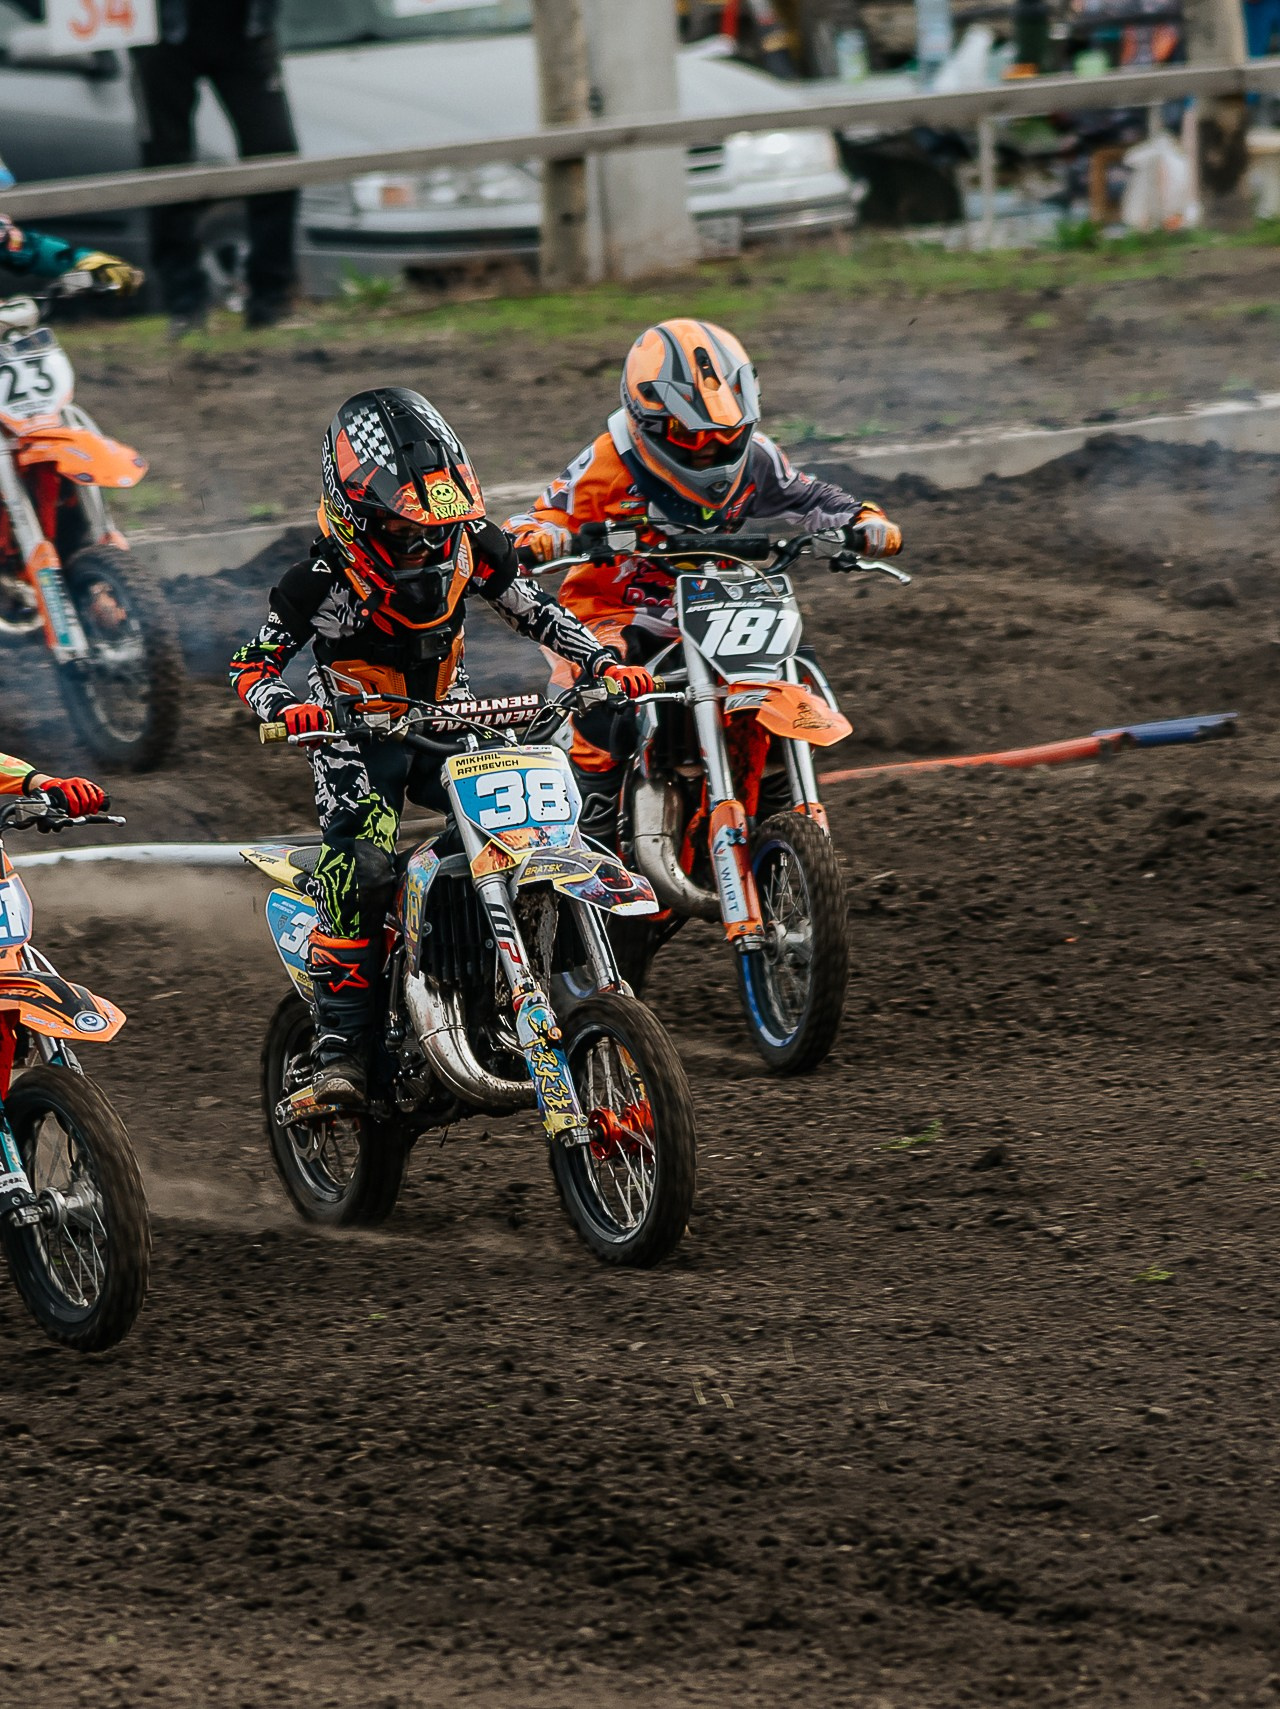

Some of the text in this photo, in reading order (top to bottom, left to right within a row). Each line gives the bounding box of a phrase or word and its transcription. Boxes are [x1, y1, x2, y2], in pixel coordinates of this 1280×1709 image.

[433, 502, 470, 520] ASTARS
[699, 608, 800, 658] 181
[455, 753, 501, 767] MIKHAIL
[457, 760, 519, 776] ARTISEVICH
[475, 769, 571, 830] 38
[524, 863, 564, 876] BRATSK
[720, 866, 739, 912] WIRT
